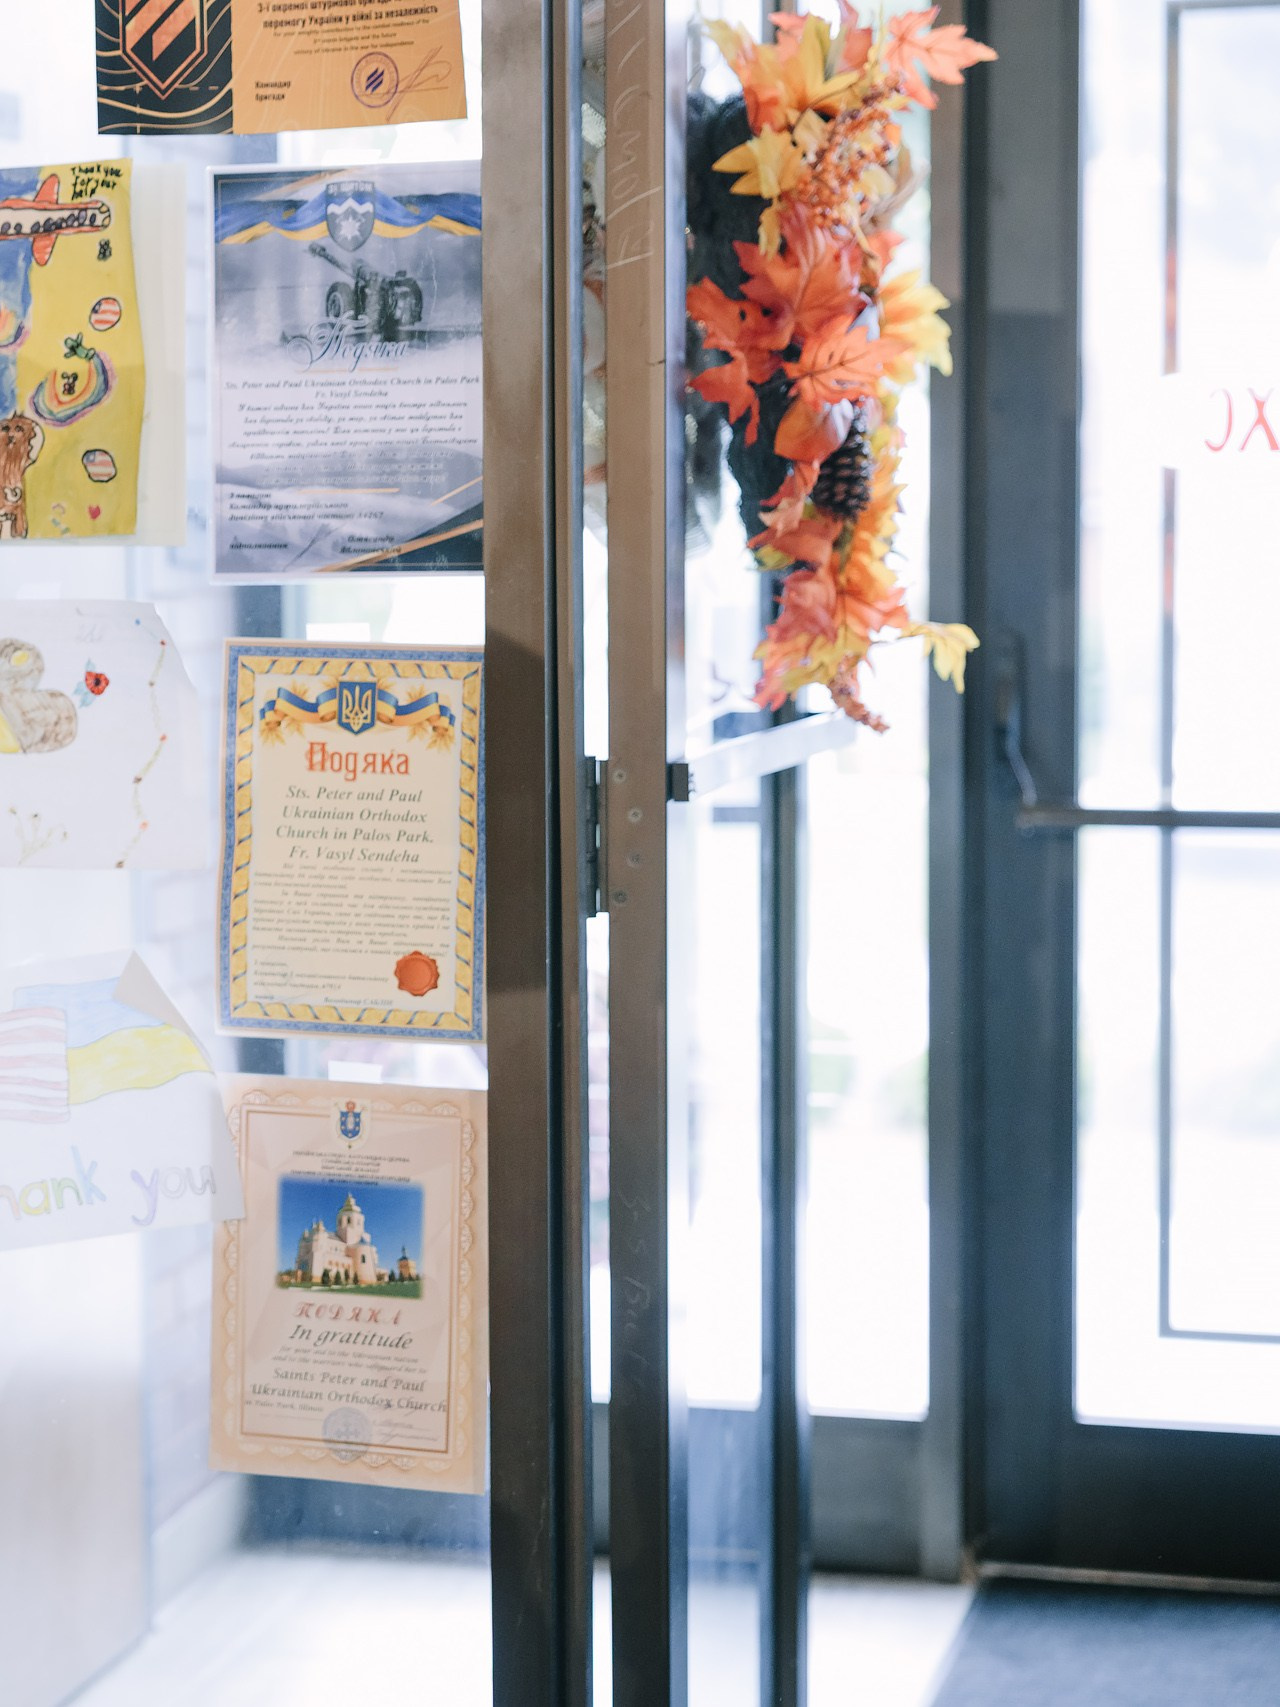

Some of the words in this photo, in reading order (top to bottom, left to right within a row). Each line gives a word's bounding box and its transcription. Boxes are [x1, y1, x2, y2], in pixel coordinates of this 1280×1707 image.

[264, 380, 281, 388] and
[390, 377, 423, 386] Church
[306, 741, 410, 781] Подяка
[286, 785, 310, 799] Sts.
[317, 787, 352, 801] Peter
[357, 788, 383, 801] and
[389, 789, 422, 803] Paul
[282, 805, 354, 821] Ukrainian
[359, 808, 427, 823] Orthodox
[275, 825, 329, 840] Church
[333, 827, 347, 840] in
[352, 828, 391, 842] Palos
[396, 829, 434, 843] Park.
[289, 845, 309, 859] Fr.
[316, 847, 355, 863] Vasyl
[357, 847, 420, 863] Sendeha
[130, 1164, 216, 1227] you
[289, 1324, 311, 1341] In
[313, 1328, 414, 1350] gratitude
[273, 1367, 315, 1382] Saints
[320, 1371, 357, 1386] Peter
[361, 1375, 388, 1389] and
[392, 1378, 425, 1392] Paul
[250, 1384, 323, 1401] Ukrainian
[326, 1390, 394, 1408] Orthodox
[397, 1396, 448, 1413] Church
